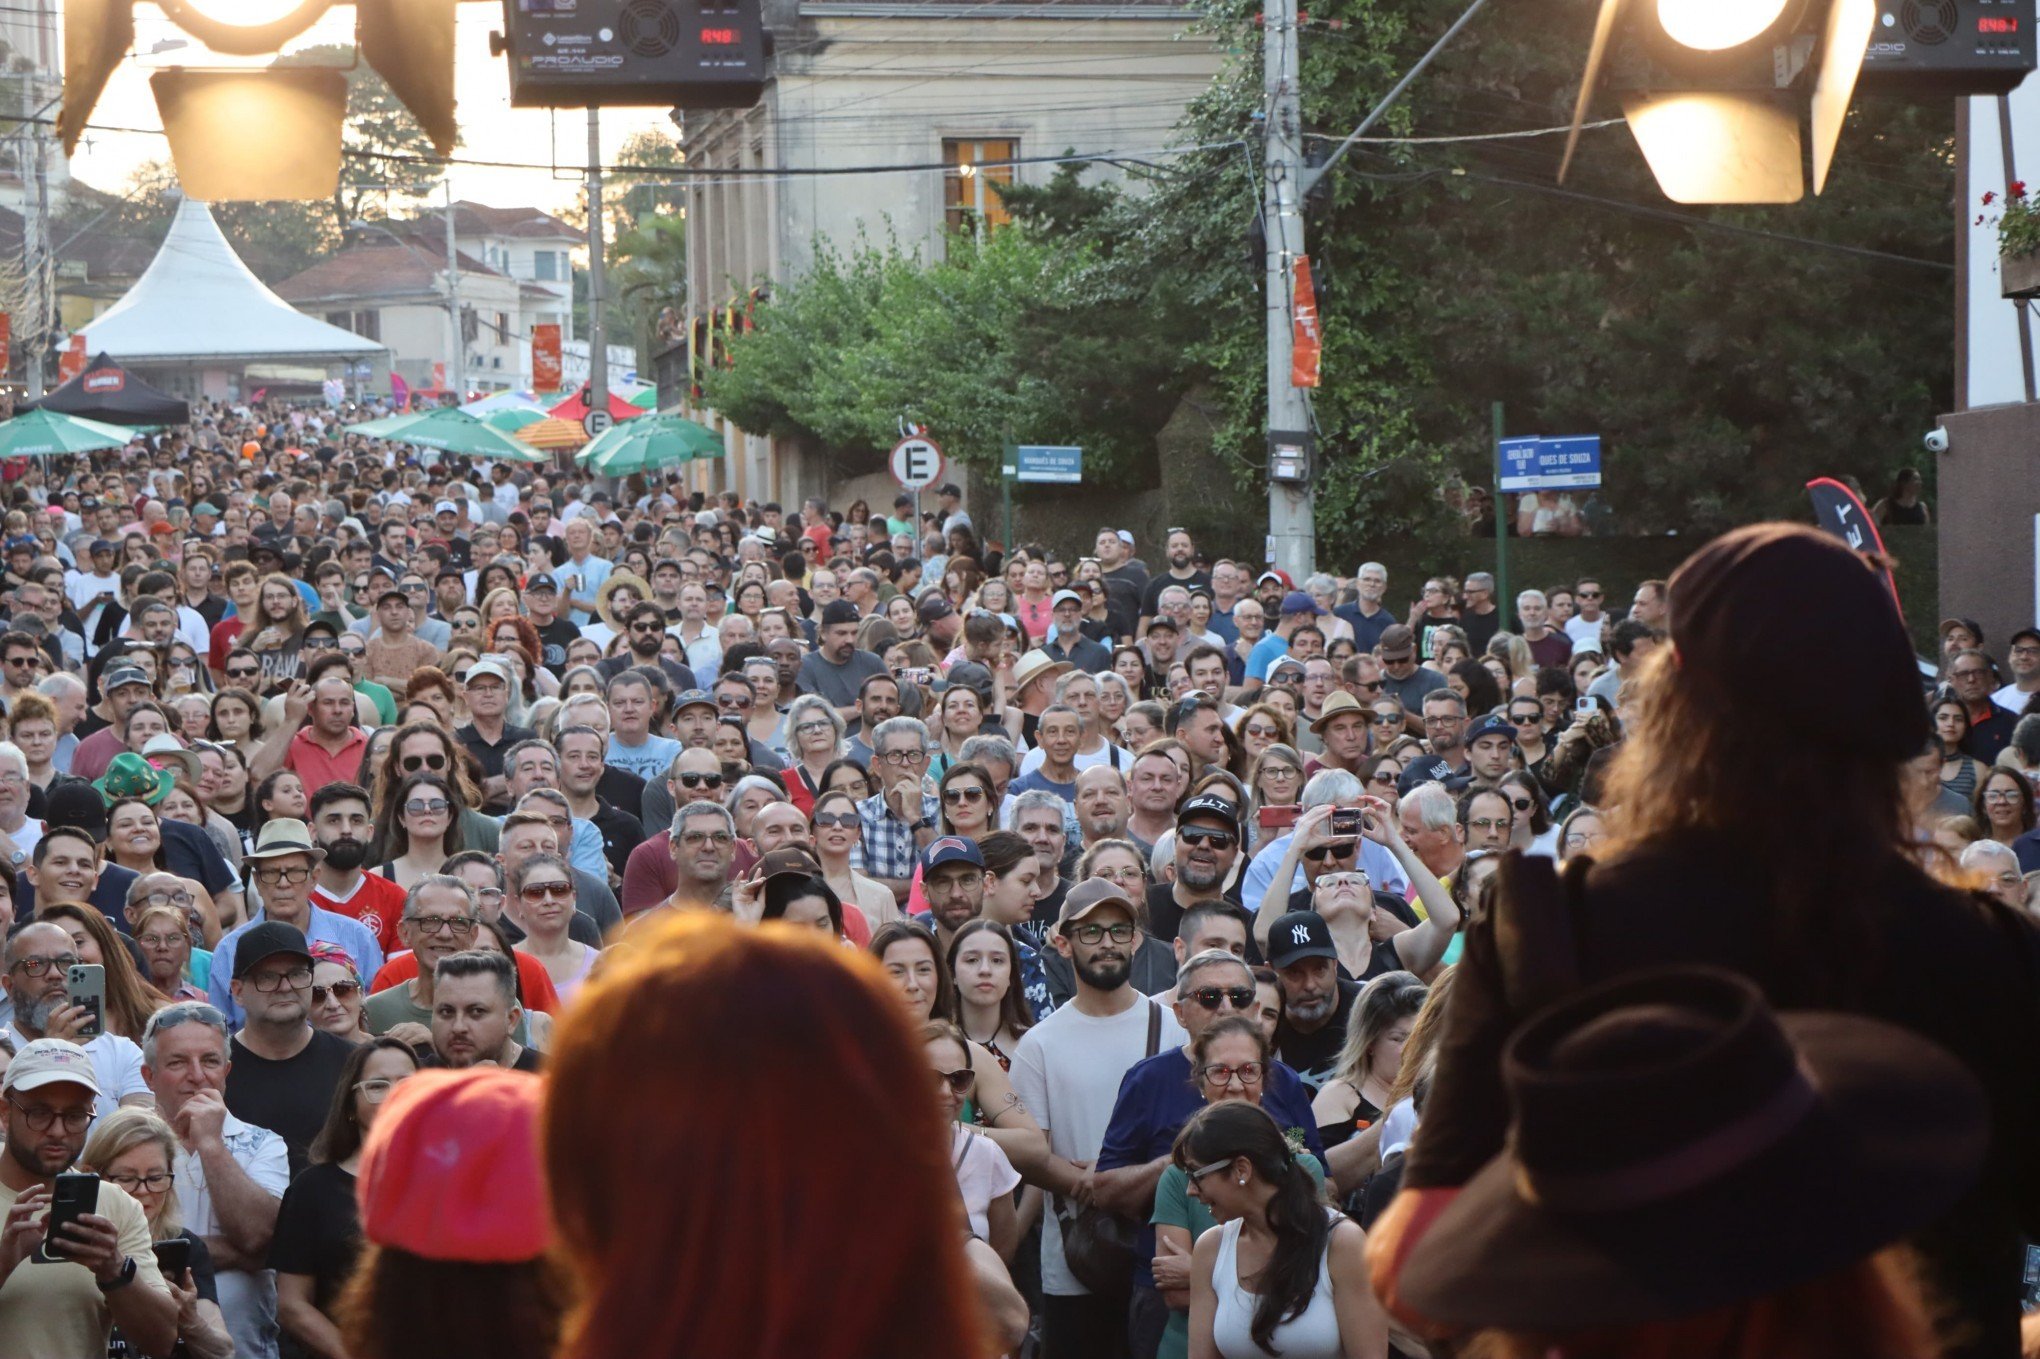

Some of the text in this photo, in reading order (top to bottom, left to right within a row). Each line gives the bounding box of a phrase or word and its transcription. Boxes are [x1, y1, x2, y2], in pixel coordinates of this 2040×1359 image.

[532, 55, 624, 65] PROAUDIO
[592, 414, 606, 434] E
[906, 446, 928, 480] E
[1558, 453, 1569, 465] DE
[1569, 452, 1591, 464] SOUZA
[262, 651, 300, 679] RAW
[1291, 924, 1311, 945] NY
